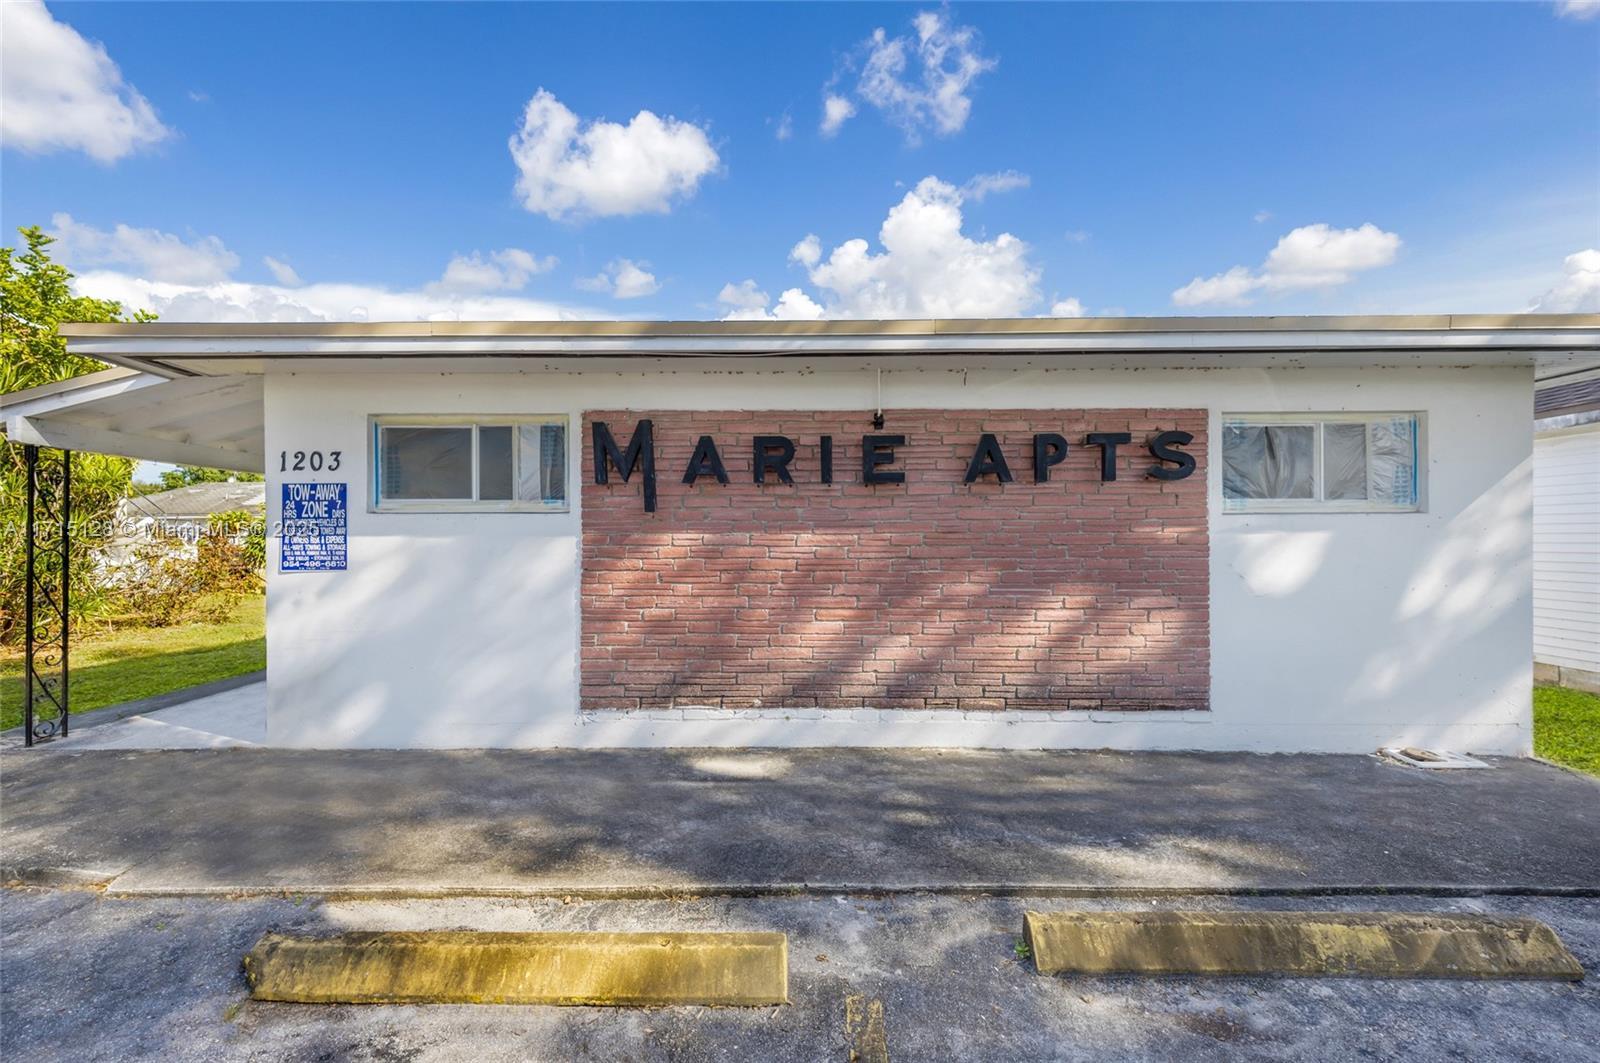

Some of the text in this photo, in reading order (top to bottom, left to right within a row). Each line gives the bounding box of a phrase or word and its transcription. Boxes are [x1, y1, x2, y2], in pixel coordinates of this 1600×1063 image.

[280, 450, 342, 472] 1203
[591, 419, 906, 513] MARIE
[964, 430, 1196, 485] APTS
[288, 484, 341, 501] TOW-AWAY
[285, 500, 295, 509] 24
[301, 501, 329, 518] ZONE
[336, 500, 342, 509] 7
[283, 509, 297, 518] HRS
[332, 509, 345, 518] DAYS
